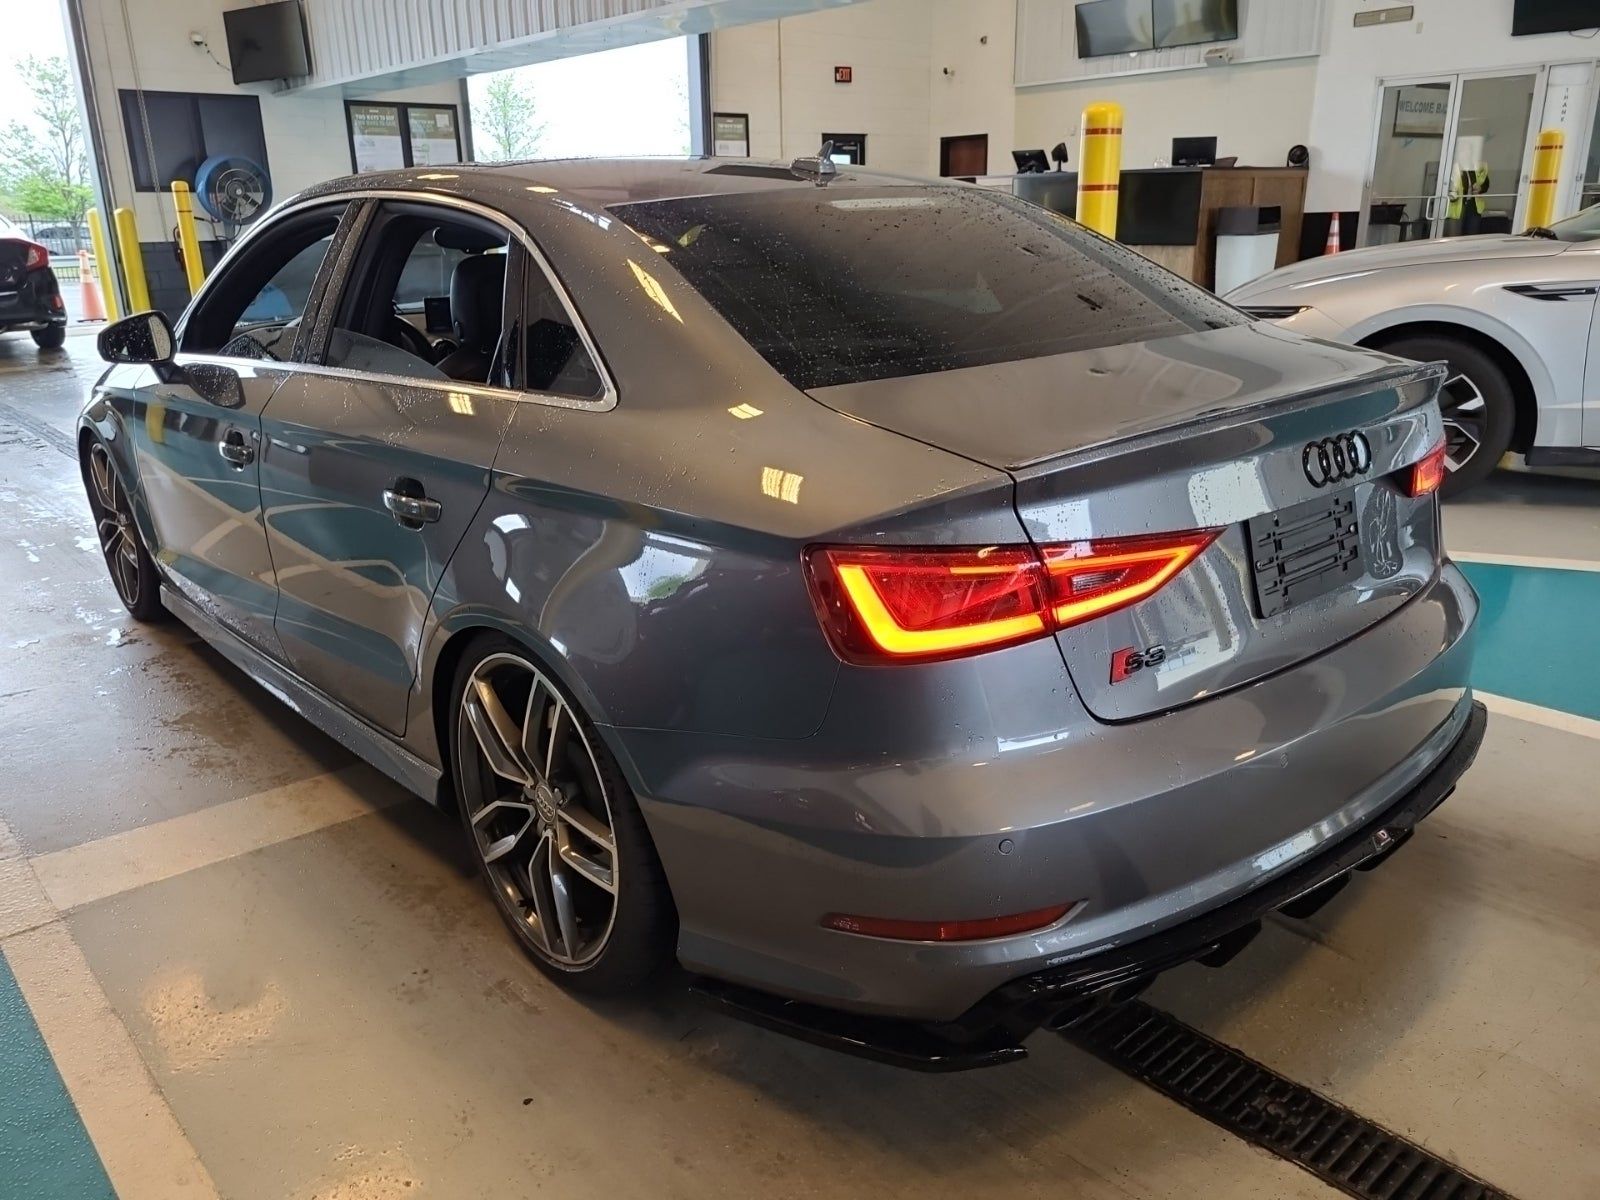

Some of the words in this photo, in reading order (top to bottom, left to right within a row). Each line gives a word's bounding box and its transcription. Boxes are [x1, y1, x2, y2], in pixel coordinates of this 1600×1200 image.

[838, 68, 851, 81] EXIT
[1398, 100, 1435, 113] WELCOME
[1123, 644, 1166, 675] S3
